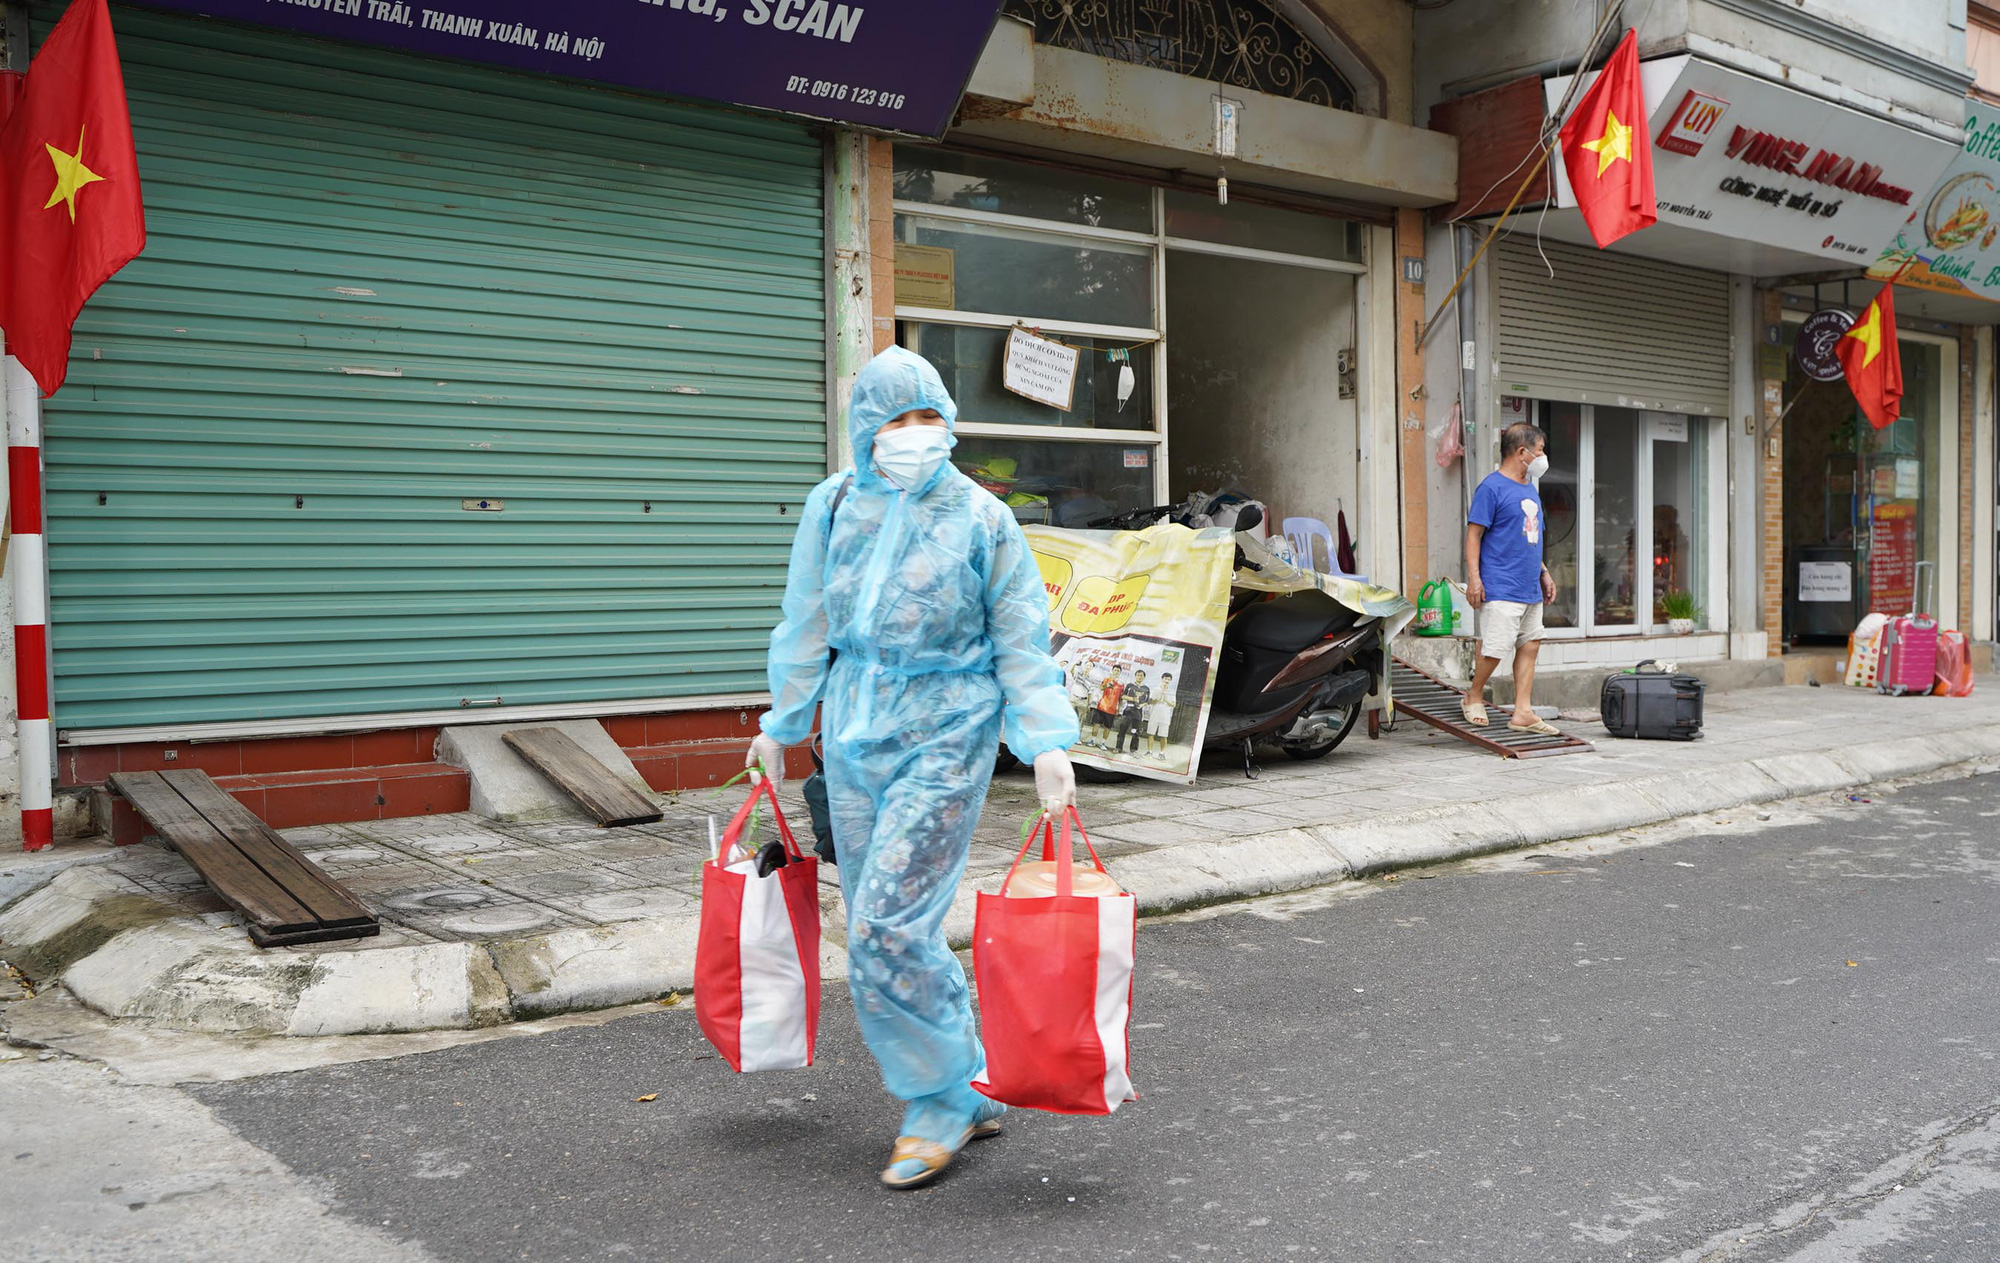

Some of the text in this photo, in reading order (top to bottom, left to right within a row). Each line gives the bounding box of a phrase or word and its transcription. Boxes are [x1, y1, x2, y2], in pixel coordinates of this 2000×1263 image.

[742, 0, 864, 43] SCAN
[367, 0, 413, 28] TRÃI,
[421, 9, 483, 38] THANH
[544, 28, 569, 53] HÀ
[572, 37, 605, 61] NỘI
[811, 79, 847, 100] 0916
[850, 87, 877, 105] 123
[878, 92, 905, 110] 916
[1407, 260, 1422, 279] 10
[1804, 316, 1829, 333] Coffee
[1042, 347, 1073, 362] COVID-19
[1044, 582, 1061, 596] AR
[1107, 593, 1125, 603] DP
[1424, 610, 1437, 621] NET
